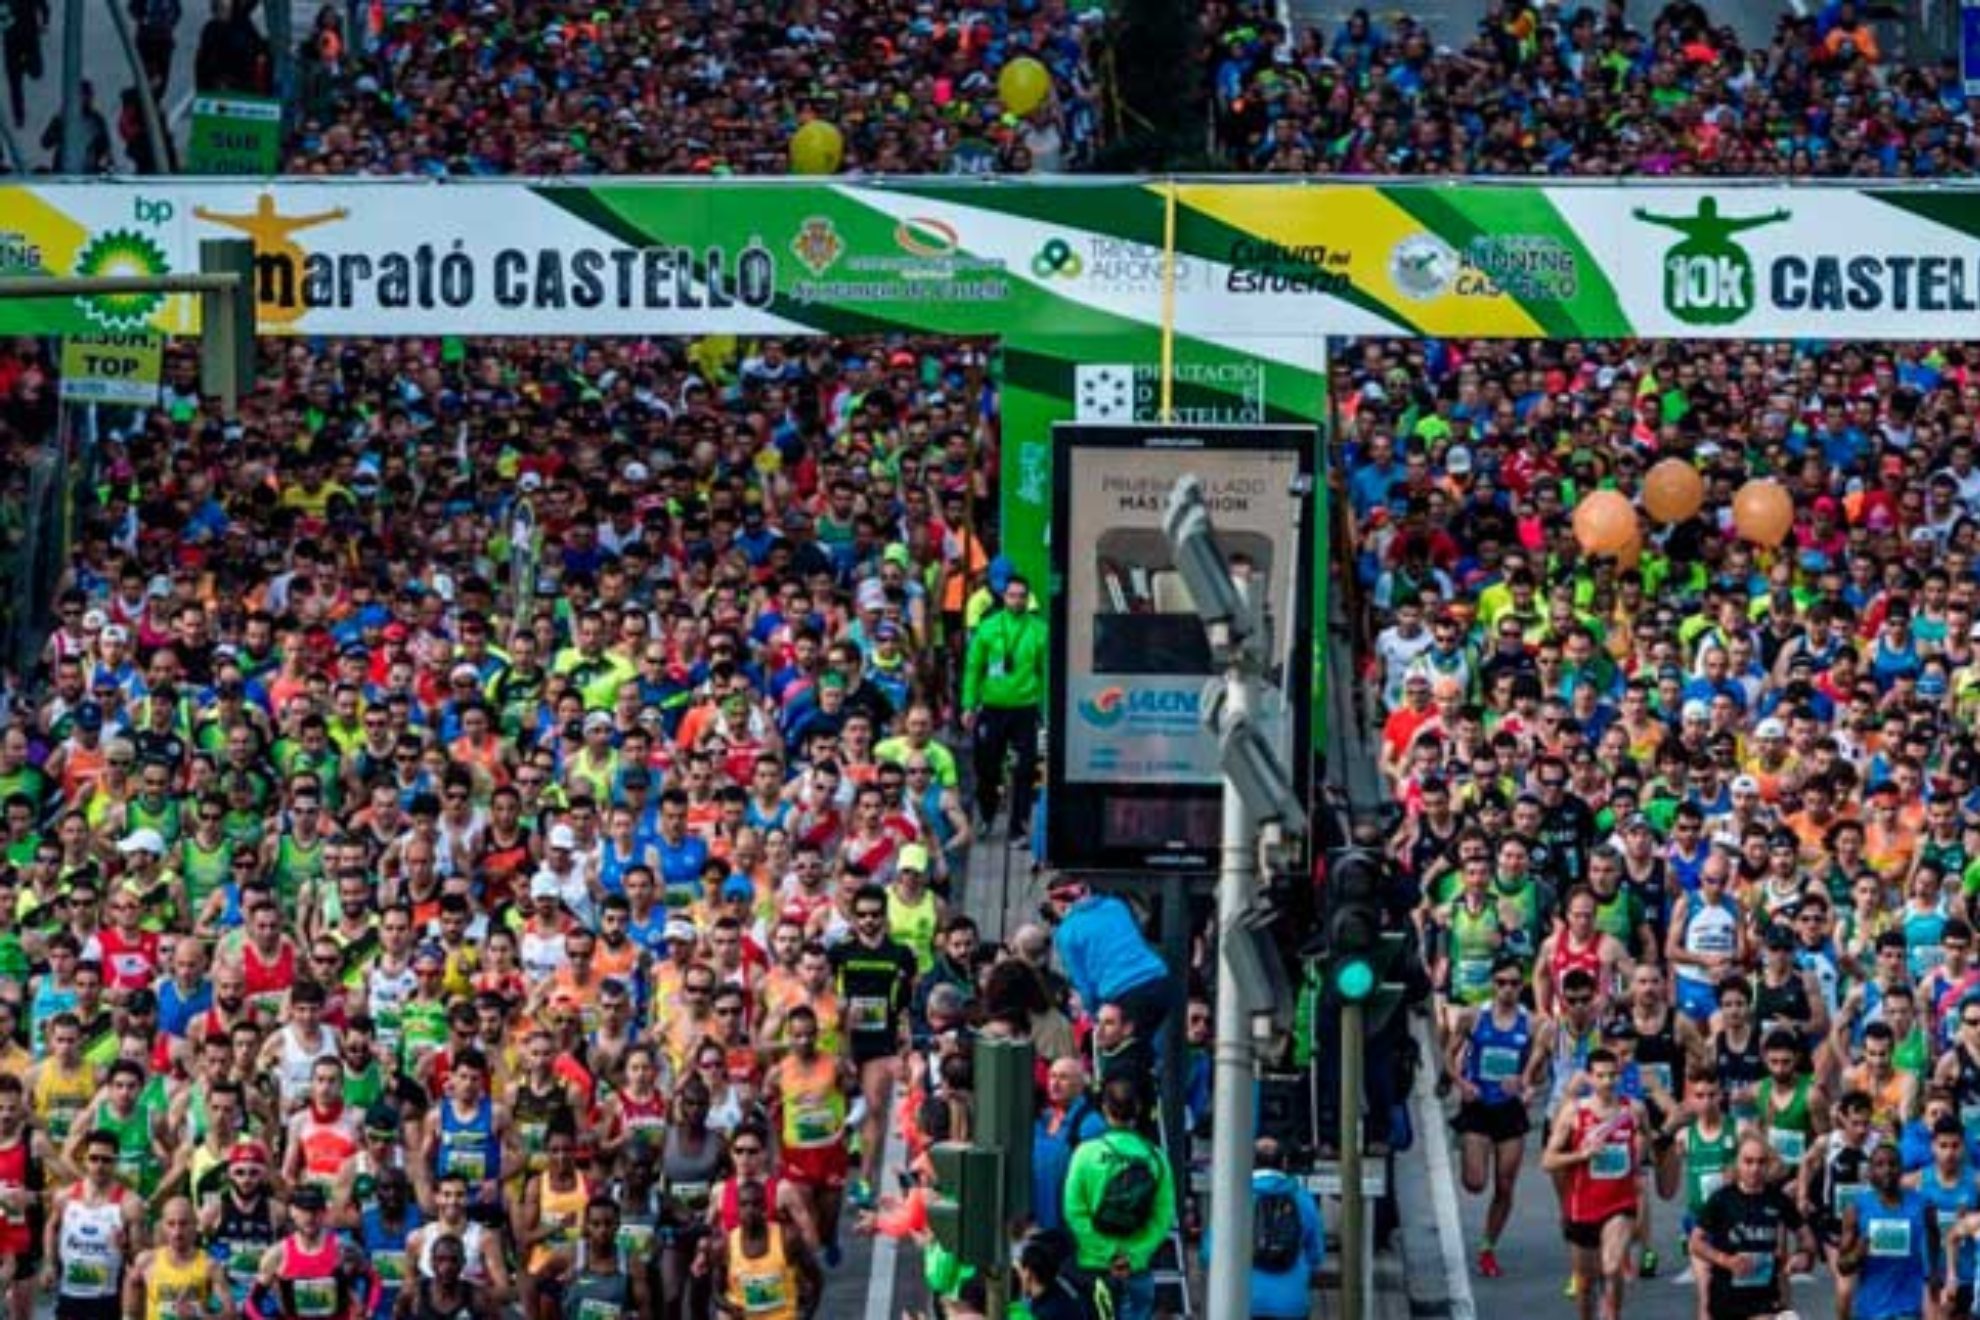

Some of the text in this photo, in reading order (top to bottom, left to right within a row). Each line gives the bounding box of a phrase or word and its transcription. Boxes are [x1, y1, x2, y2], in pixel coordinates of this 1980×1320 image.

[134, 197, 173, 225] bp
[254, 234, 774, 311] marató CASTELLÓ
[84, 356, 139, 377] TOP
